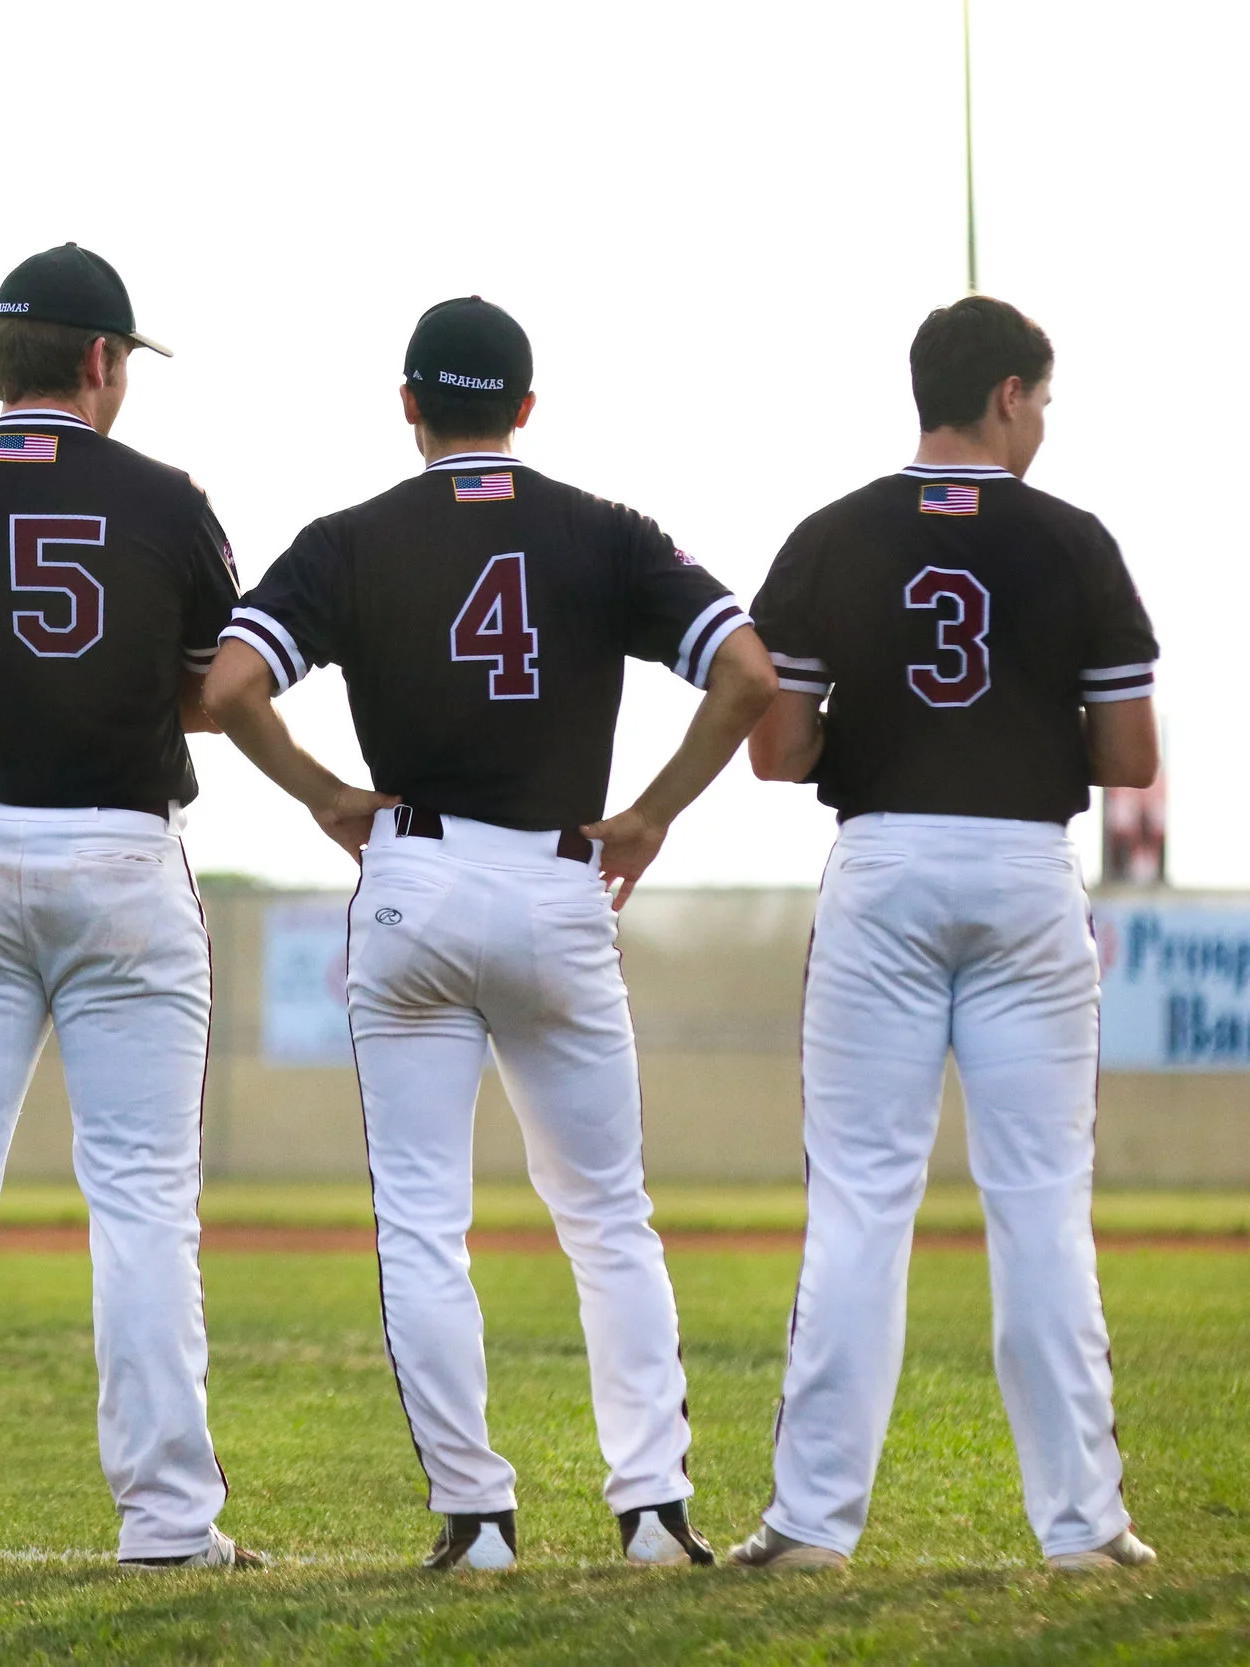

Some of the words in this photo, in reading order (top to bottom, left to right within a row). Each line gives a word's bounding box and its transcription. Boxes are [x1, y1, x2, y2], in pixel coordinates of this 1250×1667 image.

[438, 370, 504, 390] BRAHMAS
[450, 551, 540, 700] 4
[904, 565, 992, 708] 3
